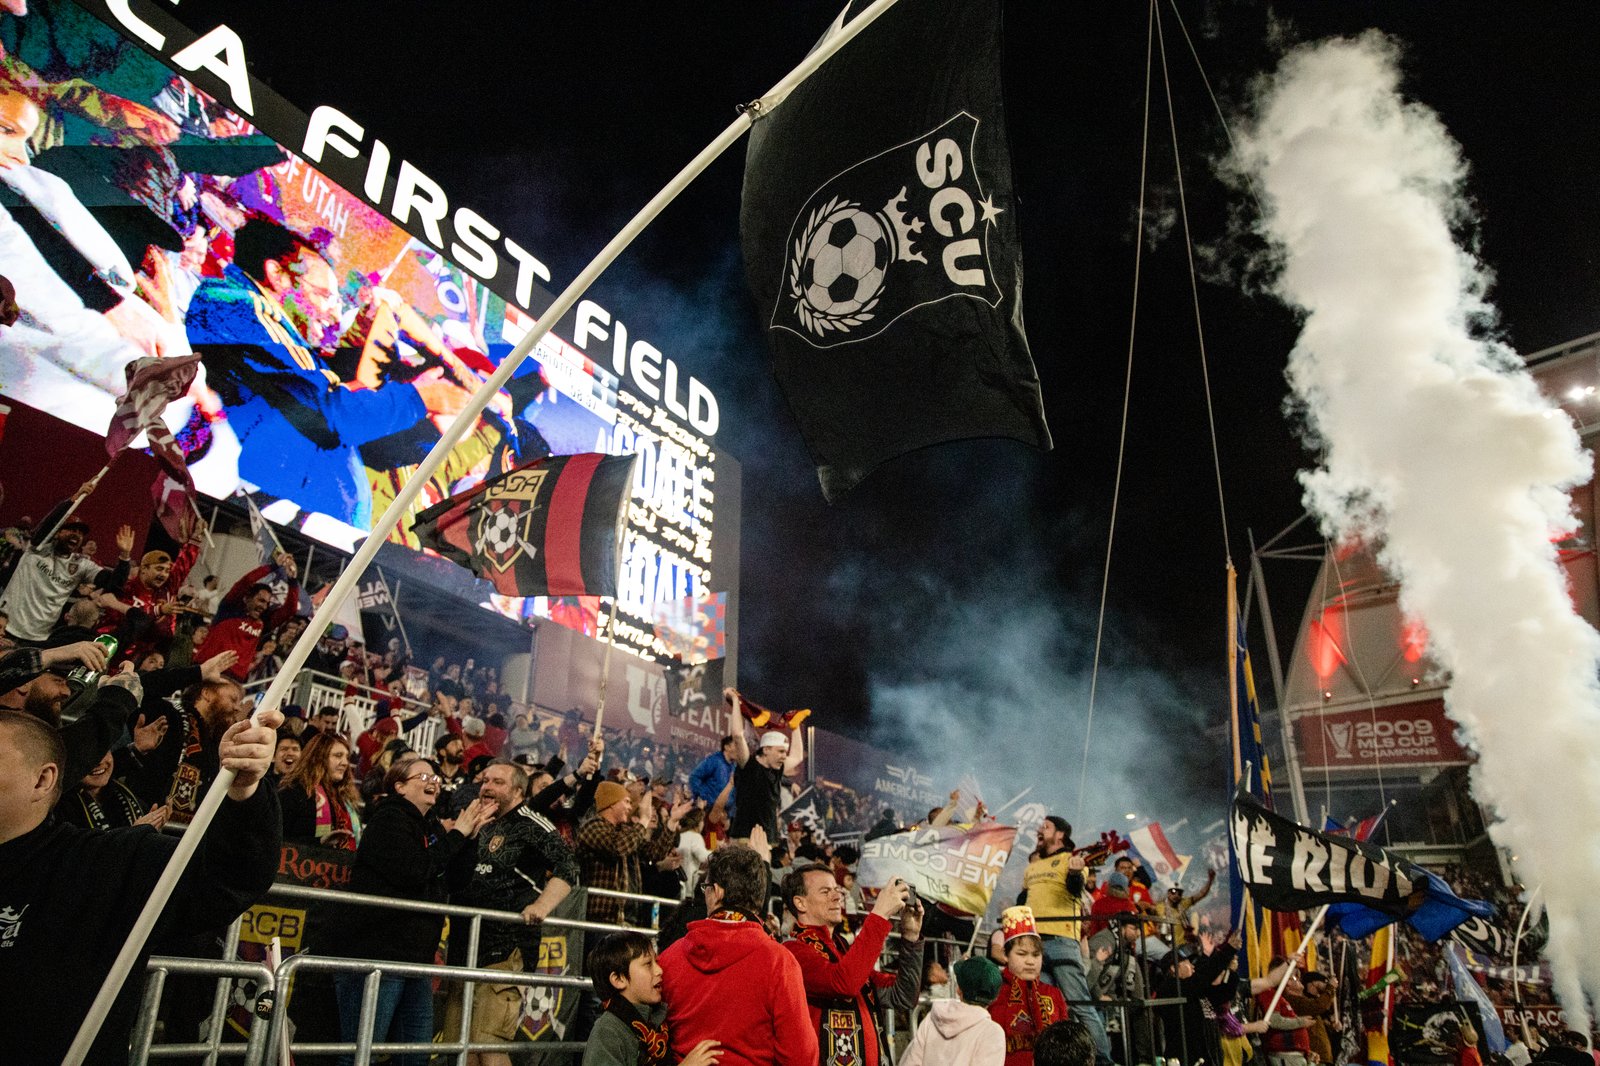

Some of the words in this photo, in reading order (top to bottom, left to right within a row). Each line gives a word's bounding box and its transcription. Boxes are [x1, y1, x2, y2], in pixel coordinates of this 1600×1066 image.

[302, 167, 349, 238] UTAH
[915, 138, 986, 287] SCU
[302, 105, 551, 310] FIRST
[573, 299, 720, 436] FIELD
[1355, 719, 1433, 737] 2009
[1357, 737, 1396, 749] MLS
[1397, 736, 1436, 748] CUP
[1360, 747, 1438, 758] CHAMPIONS
[874, 778, 918, 801] AMERICA
[831, 1013, 853, 1027] RCB
